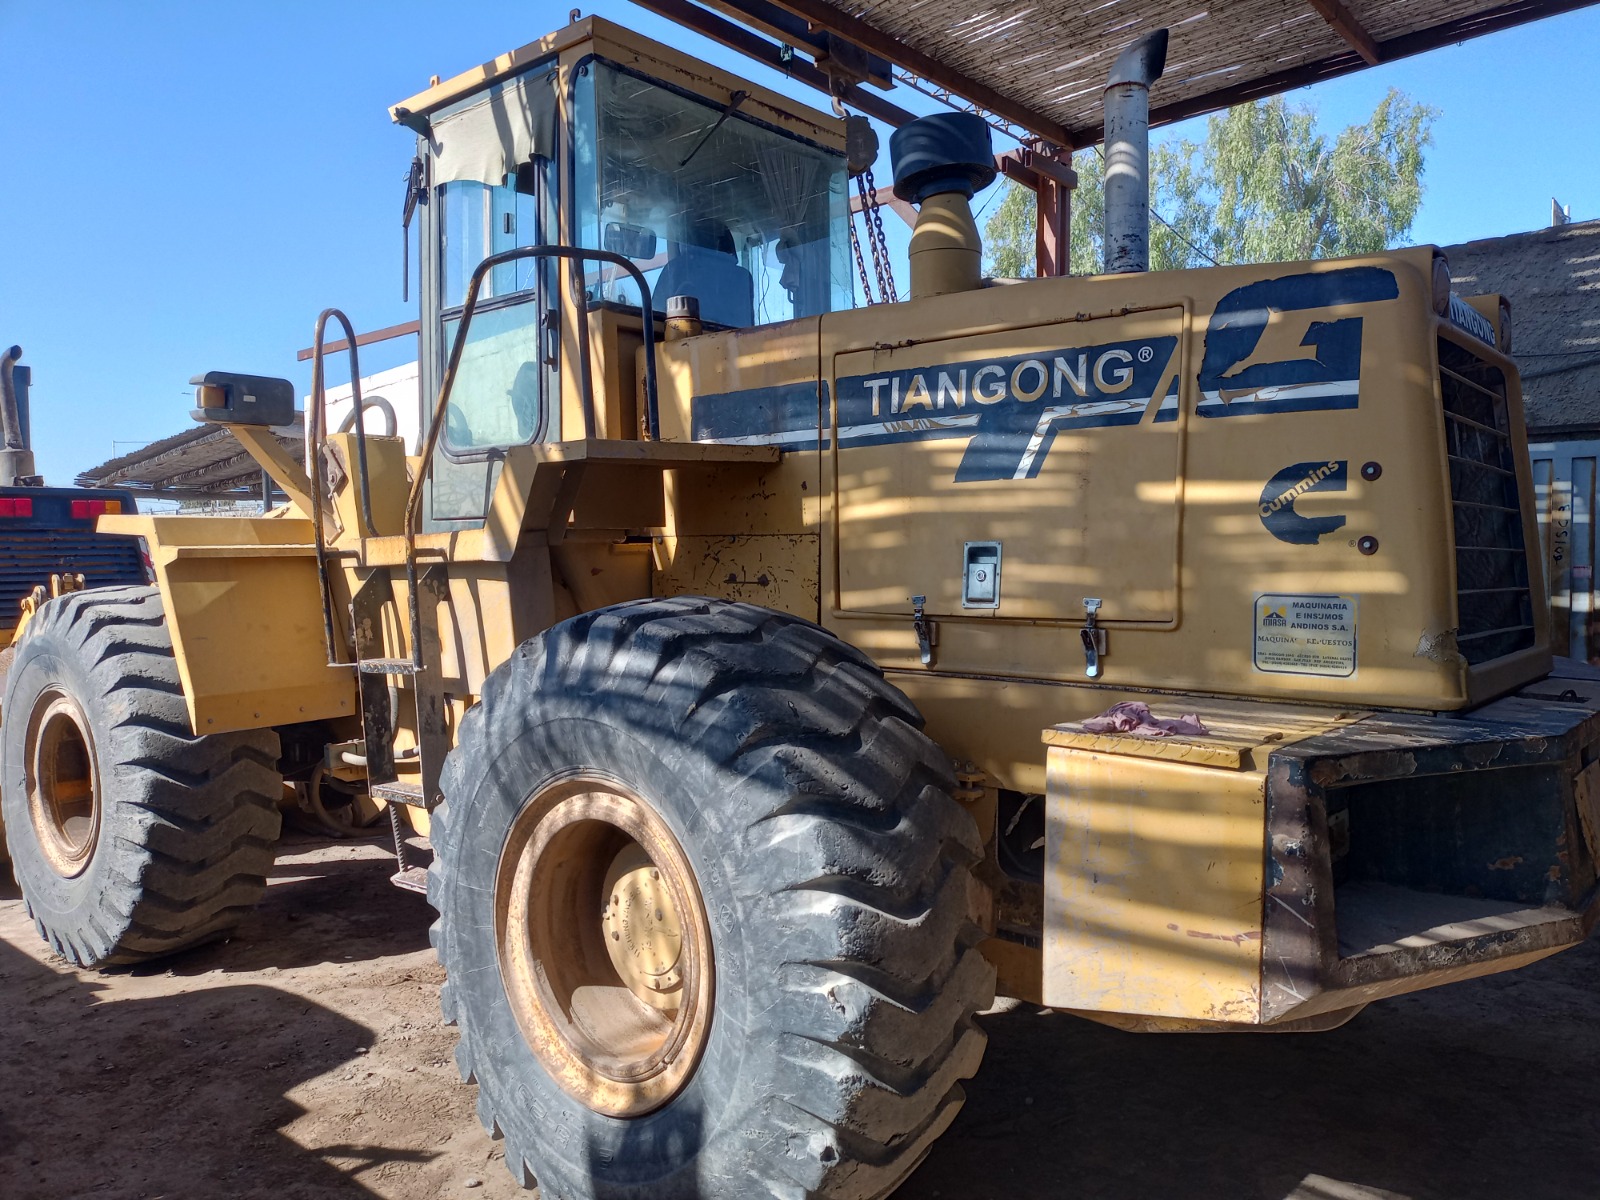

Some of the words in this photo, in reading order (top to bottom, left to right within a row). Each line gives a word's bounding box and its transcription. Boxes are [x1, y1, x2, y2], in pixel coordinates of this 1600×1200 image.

[1292, 602, 1348, 610] MAQUINARIA
[1290, 622, 1329, 631] ANDINOS
[1331, 624, 1349, 632] S.A.
